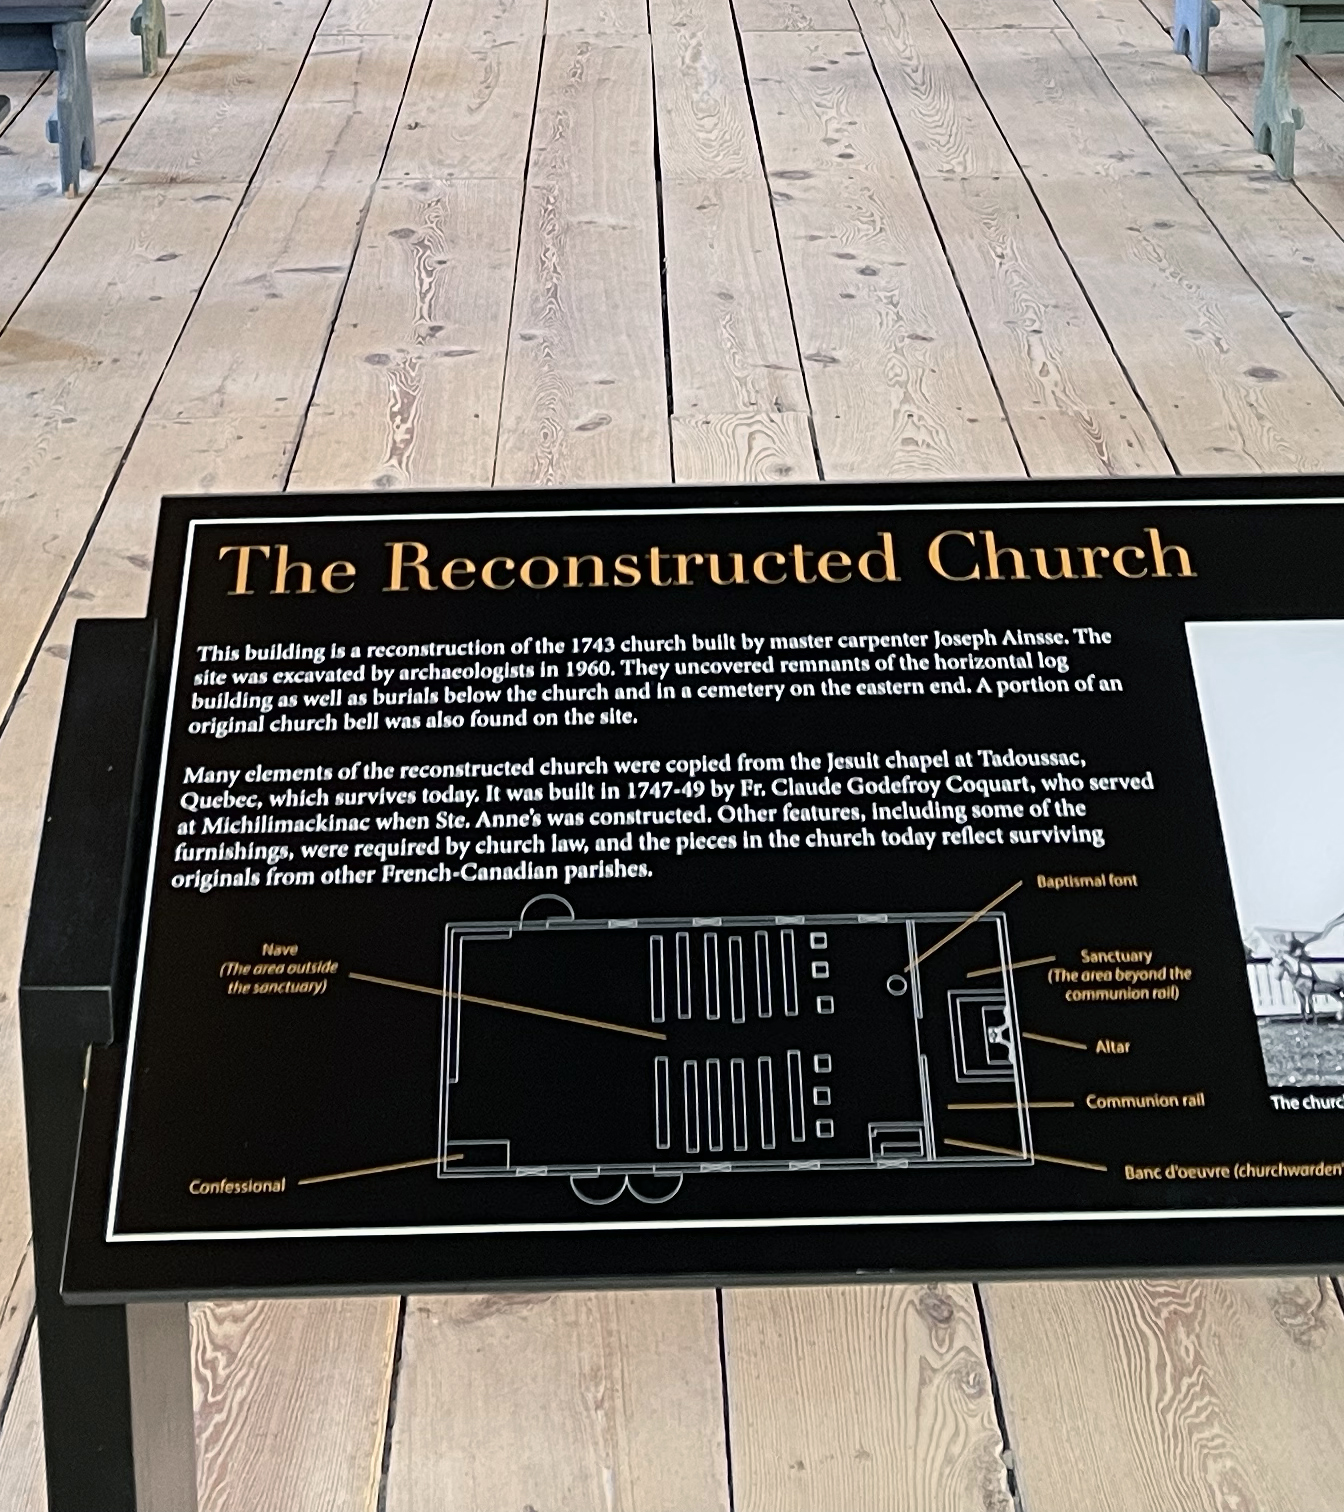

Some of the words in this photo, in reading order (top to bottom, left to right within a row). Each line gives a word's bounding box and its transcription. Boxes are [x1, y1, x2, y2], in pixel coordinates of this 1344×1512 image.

[218, 544, 356, 595] The
[382, 531, 902, 592] Reconstructed
[928, 527, 1198, 581] Church
[196, 645, 240, 661] This
[245, 643, 326, 665] building
[330, 643, 346, 658] is
[350, 647, 362, 658] a
[366, 639, 506, 657] reconstruction
[510, 637, 534, 654] of
[535, 637, 566, 654] the
[572, 637, 616, 653] 1743
[620, 634, 687, 652] church
[691, 633, 737, 651] built
[741, 633, 765, 655] by
[769, 635, 834, 649] master
[837, 633, 929, 653] carpenter
[933, 629, 998, 651] Joseph
[1001, 629, 1070, 645] Ainsse.
[1072, 628, 1112, 644] The
[193, 670, 228, 685] site
[231, 672, 268, 684] was
[272, 665, 366, 683] excavated
[371, 664, 395, 687] by
[398, 662, 535, 684] archaeologists
[540, 661, 559, 677] in
[566, 660, 616, 677] 1960.
[619, 658, 670, 681] They
[674, 656, 775, 675] uncovered
[780, 657, 871, 672] remnants
[874, 654, 897, 671] of
[899, 654, 930, 670] the
[933, 652, 1034, 670] horizontal
[1037, 651, 1070, 674] log
[191, 691, 274, 714] building
[277, 695, 298, 707] as
[303, 689, 342, 706] well
[347, 694, 368, 705] as
[372, 687, 439, 705] burials
[443, 686, 502, 703] below
[506, 685, 537, 702] the
[541, 683, 609, 701] church
[614, 682, 651, 699] and
[656, 683, 676, 699] in
[681, 686, 692, 698] a
[696, 683, 786, 702] cemetery
[789, 684, 816, 696] on
[820, 679, 852, 695] the
[855, 680, 925, 695] eastern
[929, 676, 972, 694] end.
[975, 677, 993, 693] A
[995, 676, 1070, 698] portion
[1074, 674, 1096, 691] of
[1098, 679, 1124, 691] an
[187, 715, 265, 739] original
[269, 713, 338, 732] church
[343, 712, 379, 730] bell
[384, 716, 421, 729] was
[425, 711, 465, 728] also
[470, 709, 528, 727] found
[532, 713, 558, 725] on
[564, 708, 595, 725] the
[599, 708, 638, 724] site.
[182, 767, 241, 789] Many
[244, 764, 333, 782] elements
[337, 762, 362, 780] of
[363, 762, 395, 779] the
[399, 758, 535, 779] reconstructed
[539, 757, 609, 775] church
[613, 760, 661, 773] were
[665, 755, 732, 778] copied
[737, 754, 785, 771] from
[790, 753, 822, 770] the
[826, 752, 881, 774] Jesuit
[885, 751, 950, 774] chapel
[954, 752, 974, 767] at
[976, 749, 1087, 768] Tadoussac,
[179, 790, 263, 813] Quebec,
[269, 788, 329, 807] which
[334, 787, 417, 805] survives
[422, 785, 480, 809] today.
[485, 785, 501, 802] It
[506, 788, 544, 801] was
[548, 782, 595, 801] built
[600, 782, 620, 799] in
[627, 781, 706, 799] 1747-49
[710, 779, 736, 803] by
[740, 779, 766, 796] Fr.
[770, 777, 842, 796] Claude
[846, 776, 942, 799] Godefroy
[945, 775, 1036, 798] Coquart,
[1040, 773, 1085, 791] who
[1089, 771, 1155, 790] served
[176, 820, 197, 835] at
[201, 813, 371, 834] Michilimackinac
[375, 812, 430, 830] when
[435, 811, 471, 829] Ste.
[546, 813, 585, 826] was
[589, 805, 712, 825] constructed.
[717, 804, 778, 823] Other
[782, 803, 866, 823] features,
[872, 801, 968, 825] including
[971, 804, 1024, 818] some
[1029, 798, 1052, 817] of
[1054, 798, 1087, 817] the
[174, 842, 295, 865] furnishings,
[300, 844, 349, 858] were
[354, 836, 440, 861] required
[445, 836, 471, 860] by
[475, 834, 546, 854] church
[551, 834, 589, 855] law,
[594, 833, 633, 851] and
[638, 832, 671, 850] the
[675, 832, 738, 856] pieces
[742, 831, 763, 848] in
[768, 830, 801, 848] the
[805, 829, 876, 847] church
[881, 828, 937, 851] today
[941, 827, 1004, 845] reflect
[1009, 826, 1106, 849] surviving
[171, 867, 261, 892] originals
[265, 867, 315, 886] from
[320, 865, 377, 884] other
[381, 861, 558, 883] French-Canadian
[564, 859, 653, 884] parishes.
[1036, 874, 1107, 890] Baptismal
[1108, 874, 1138, 886] font
[261, 943, 299, 956] Nave
[1080, 950, 1153, 965] Sanctuary
[219, 962, 252, 978] (The
[252, 964, 286, 974] area
[286, 960, 339, 974] outside
[1047, 969, 1079, 985] (The
[1080, 971, 1113, 981] area
[1114, 967, 1167, 985] beyond
[1169, 966, 1192, 980] the
[227, 981, 252, 994] the
[252, 979, 328, 996] sanctuary)
[1065, 987, 1150, 1001] communion
[1152, 985, 1180, 1000] rail)
[1095, 1040, 1131, 1053] Altar
[1085, 1094, 1179, 1108] Communion
[1182, 1093, 1205, 1107] rail
[1269, 1095, 1300, 1109] The
[1124, 1165, 1163, 1179] Banc
[188, 1177, 286, 1194] Confessional
